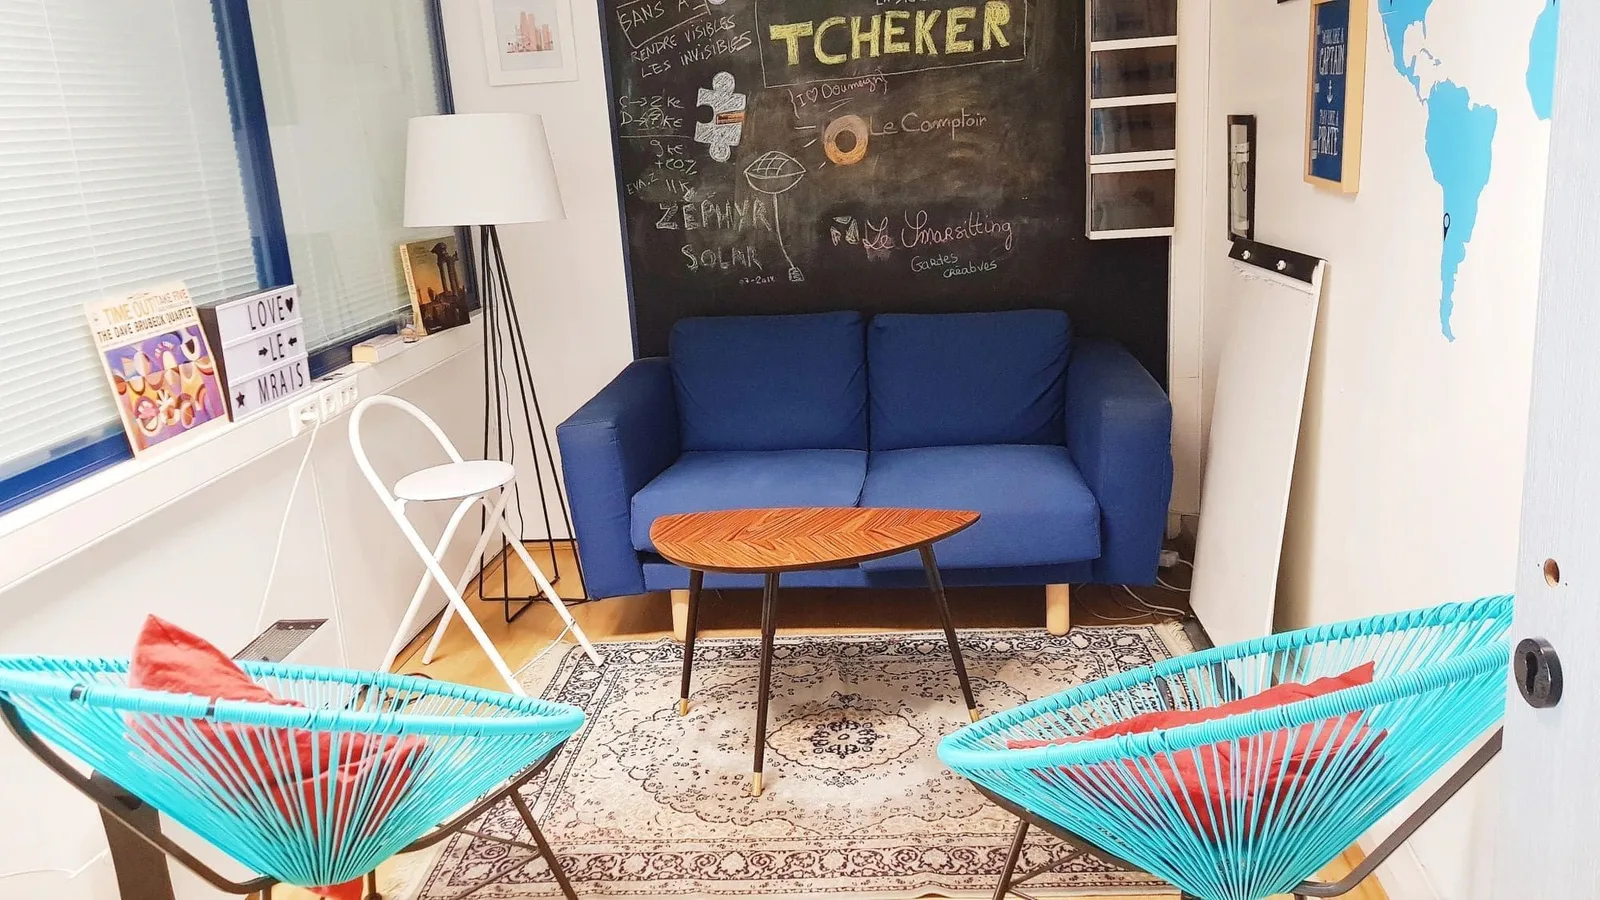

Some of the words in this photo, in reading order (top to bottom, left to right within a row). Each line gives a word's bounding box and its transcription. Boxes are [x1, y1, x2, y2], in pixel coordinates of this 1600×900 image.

[619, 0, 665, 32] SANS
[630, 34, 678, 62] RENDRE
[769, 0, 1012, 66] TCHEKER
[641, 60, 672, 78] LES
[1319, 44, 1345, 76] CAPTAIN
[869, 116, 899, 136] Le
[901, 108, 987, 140] Comptoir
[1317, 125, 1339, 156] PIRATE
[681, 244, 763, 272] SOLAR
[97, 329, 113, 344] THE
[113, 322, 134, 338] DAVE
[134, 315, 166, 333] BRUBECK
[166, 306, 195, 325] QUARTET
[102, 303, 134, 326] TIME
[132, 297, 157, 318] OUT
[247, 295, 285, 330] LOVE
[268, 333, 285, 361] LE
[257, 362, 304, 404] MRAIS
